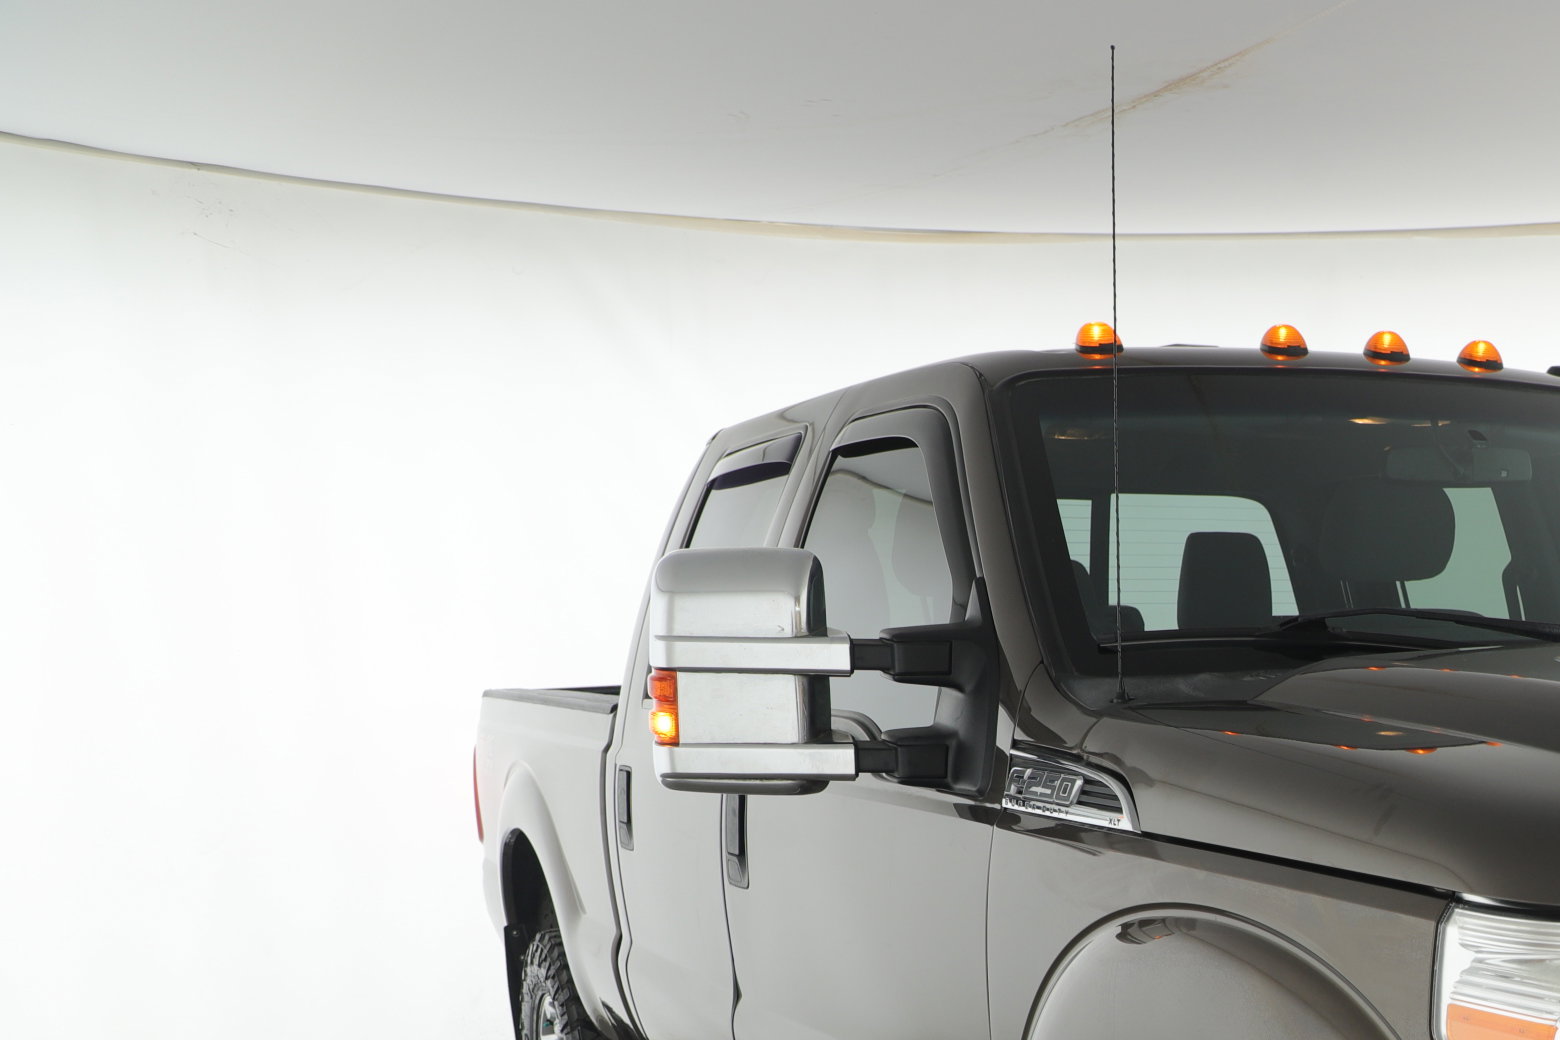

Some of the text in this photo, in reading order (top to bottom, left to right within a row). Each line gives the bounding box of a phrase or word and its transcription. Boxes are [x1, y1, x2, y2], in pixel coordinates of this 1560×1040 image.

[1004, 797, 1070, 817] SUPER DUTY
[1108, 817, 1121, 827] XLT
